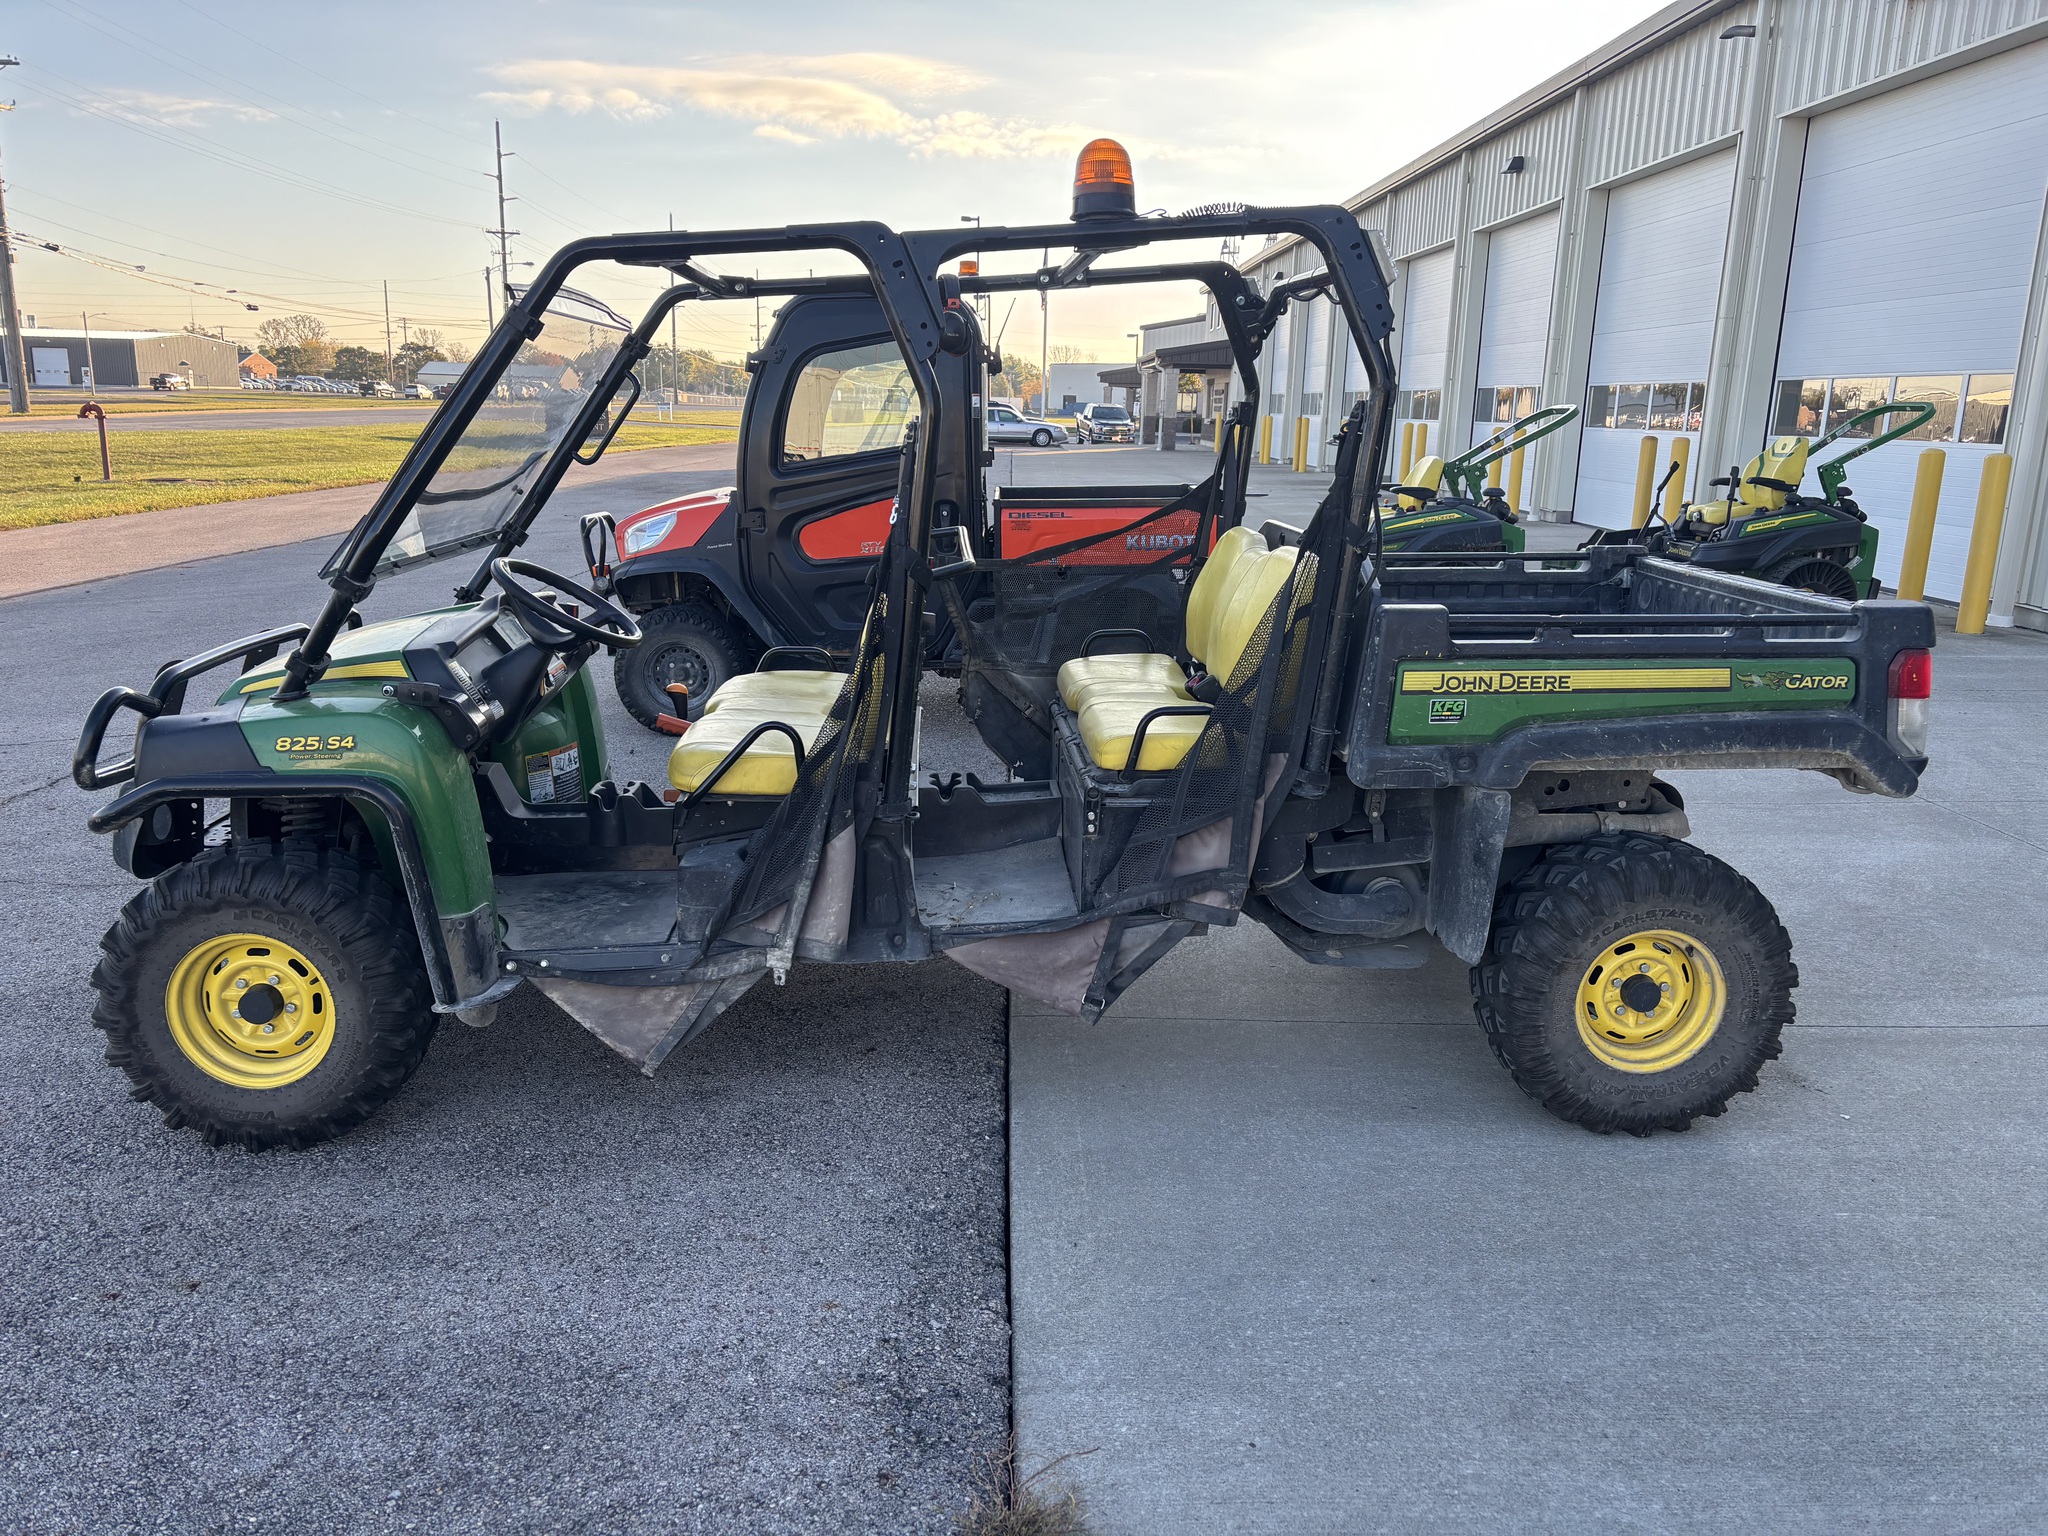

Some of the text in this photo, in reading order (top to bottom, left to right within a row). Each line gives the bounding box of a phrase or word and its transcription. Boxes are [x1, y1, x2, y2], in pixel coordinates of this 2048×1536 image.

[1126, 534, 1197, 550] KUBOT
[1432, 673, 1572, 691] JOHN DEERE
[1785, 674, 1849, 689] GATOR
[1432, 701, 1465, 712] KFG
[275, 736, 355, 751] 825i S4
[1601, 908, 1692, 937] CARLSTAR
[250, 910, 341, 968] CARLSTAR
